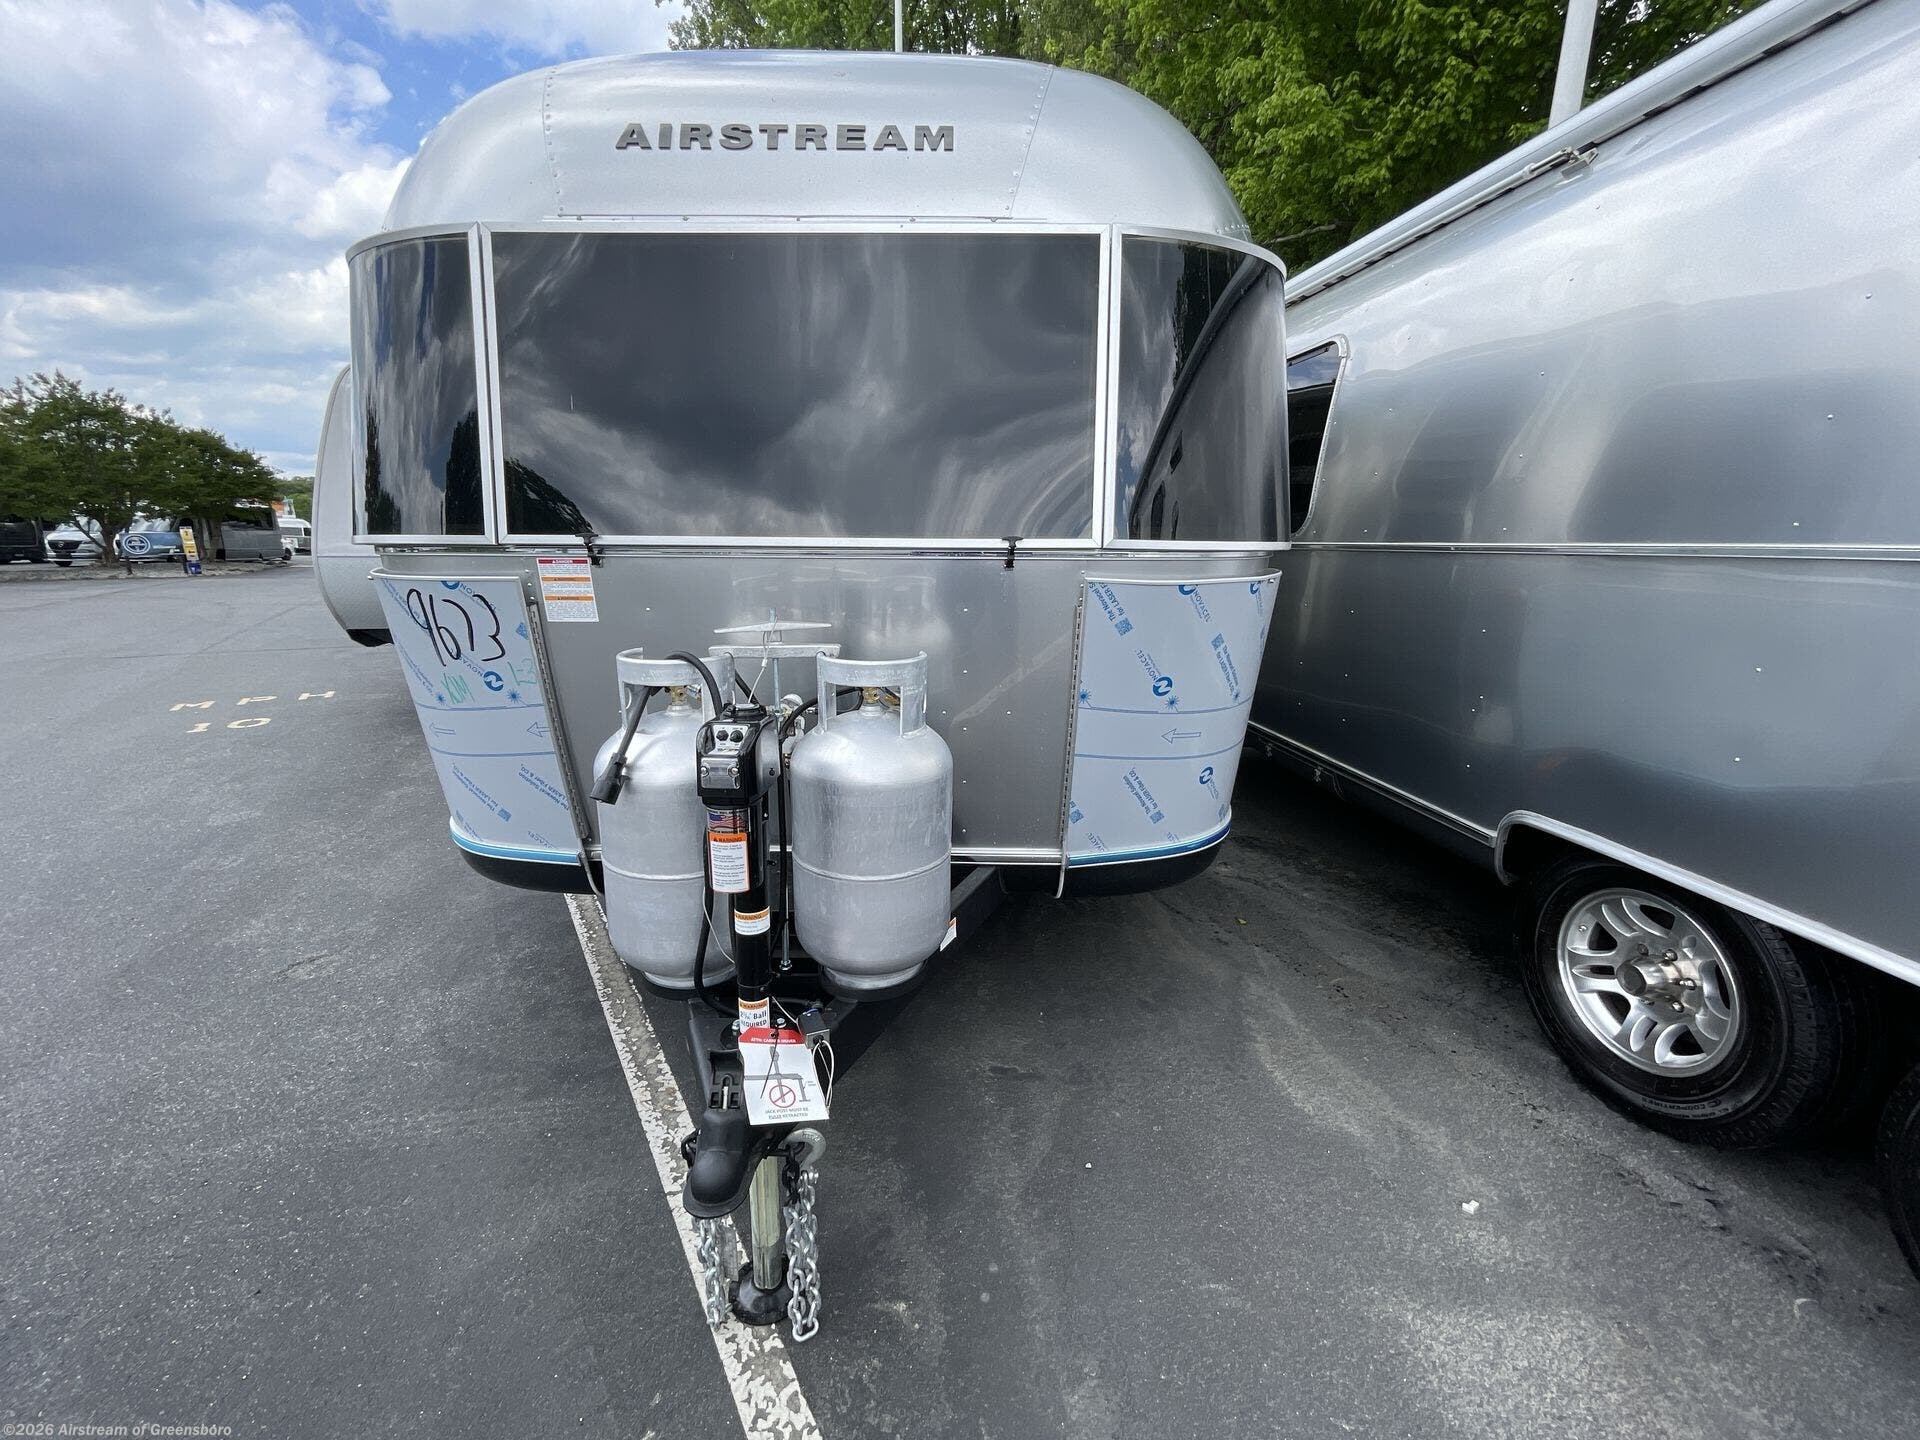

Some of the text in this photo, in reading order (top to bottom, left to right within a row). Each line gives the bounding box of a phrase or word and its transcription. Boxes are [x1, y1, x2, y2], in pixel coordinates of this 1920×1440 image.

[615, 123, 954, 151] AIRSTREAM
[1193, 590, 1211, 622] NOVACEL
[1137, 649, 1158, 681] NOVACEL
[169, 690, 336, 711] MPH
[186, 717, 272, 733] 10
